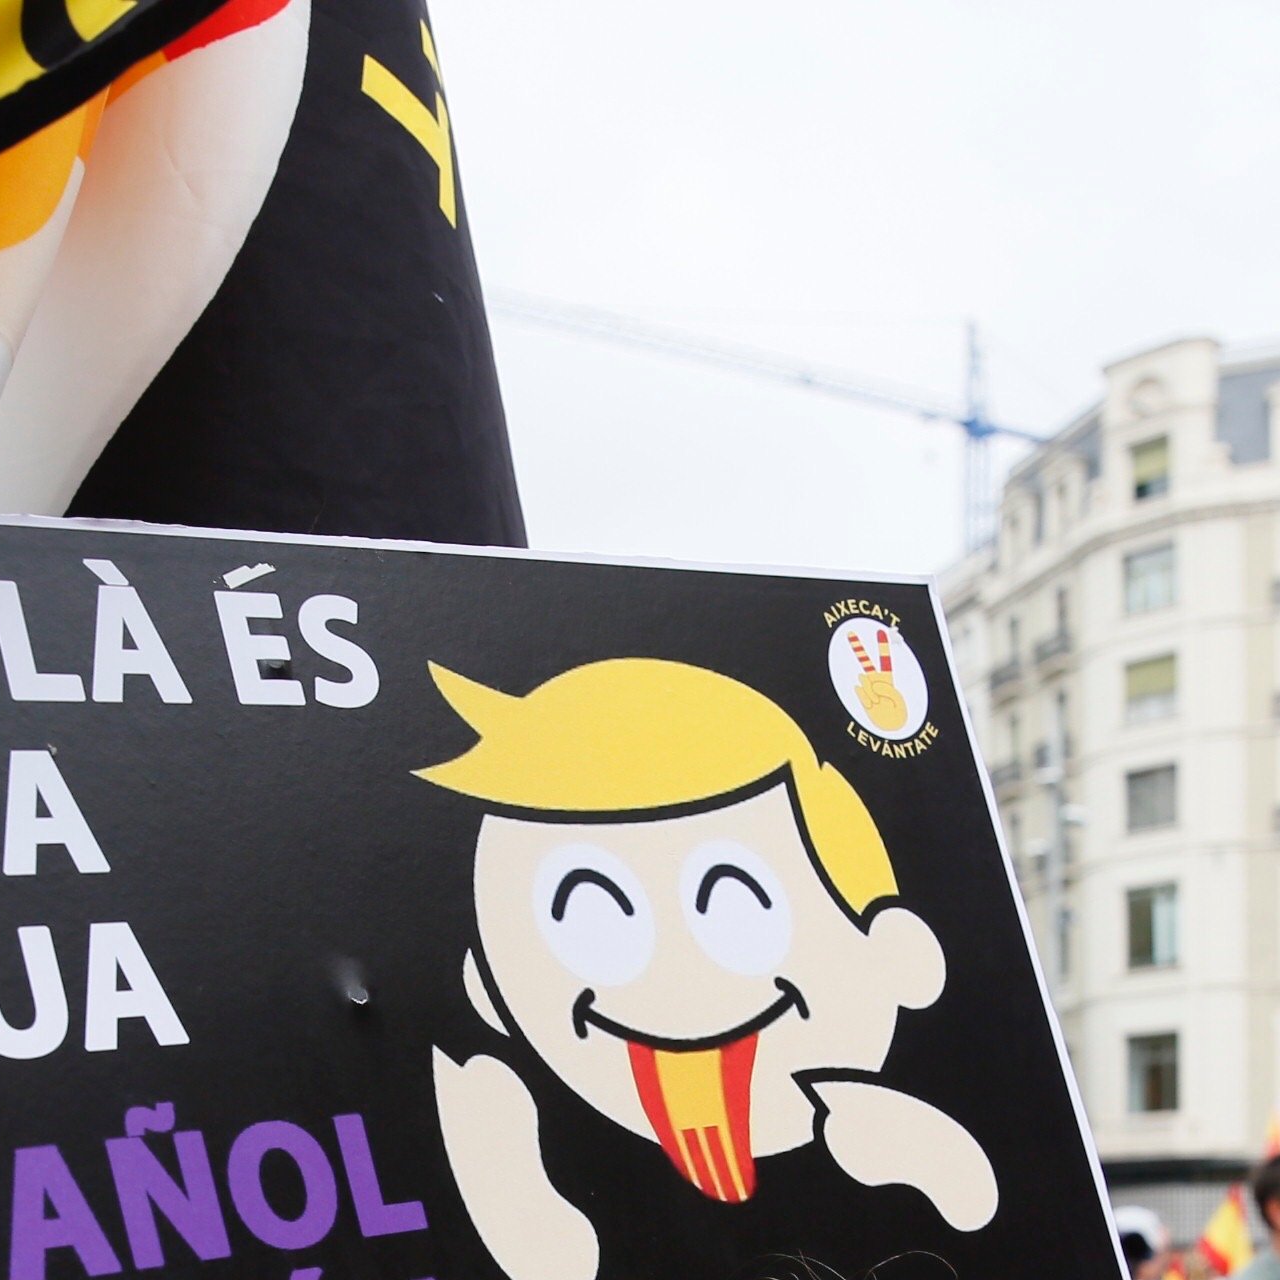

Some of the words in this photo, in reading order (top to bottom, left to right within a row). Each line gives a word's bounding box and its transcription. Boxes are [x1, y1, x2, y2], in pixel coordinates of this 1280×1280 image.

[822, 598, 902, 629] AIXECA'T
[213, 561, 381, 709] ÉS
[846, 720, 939, 760] LEVÁNTATE
